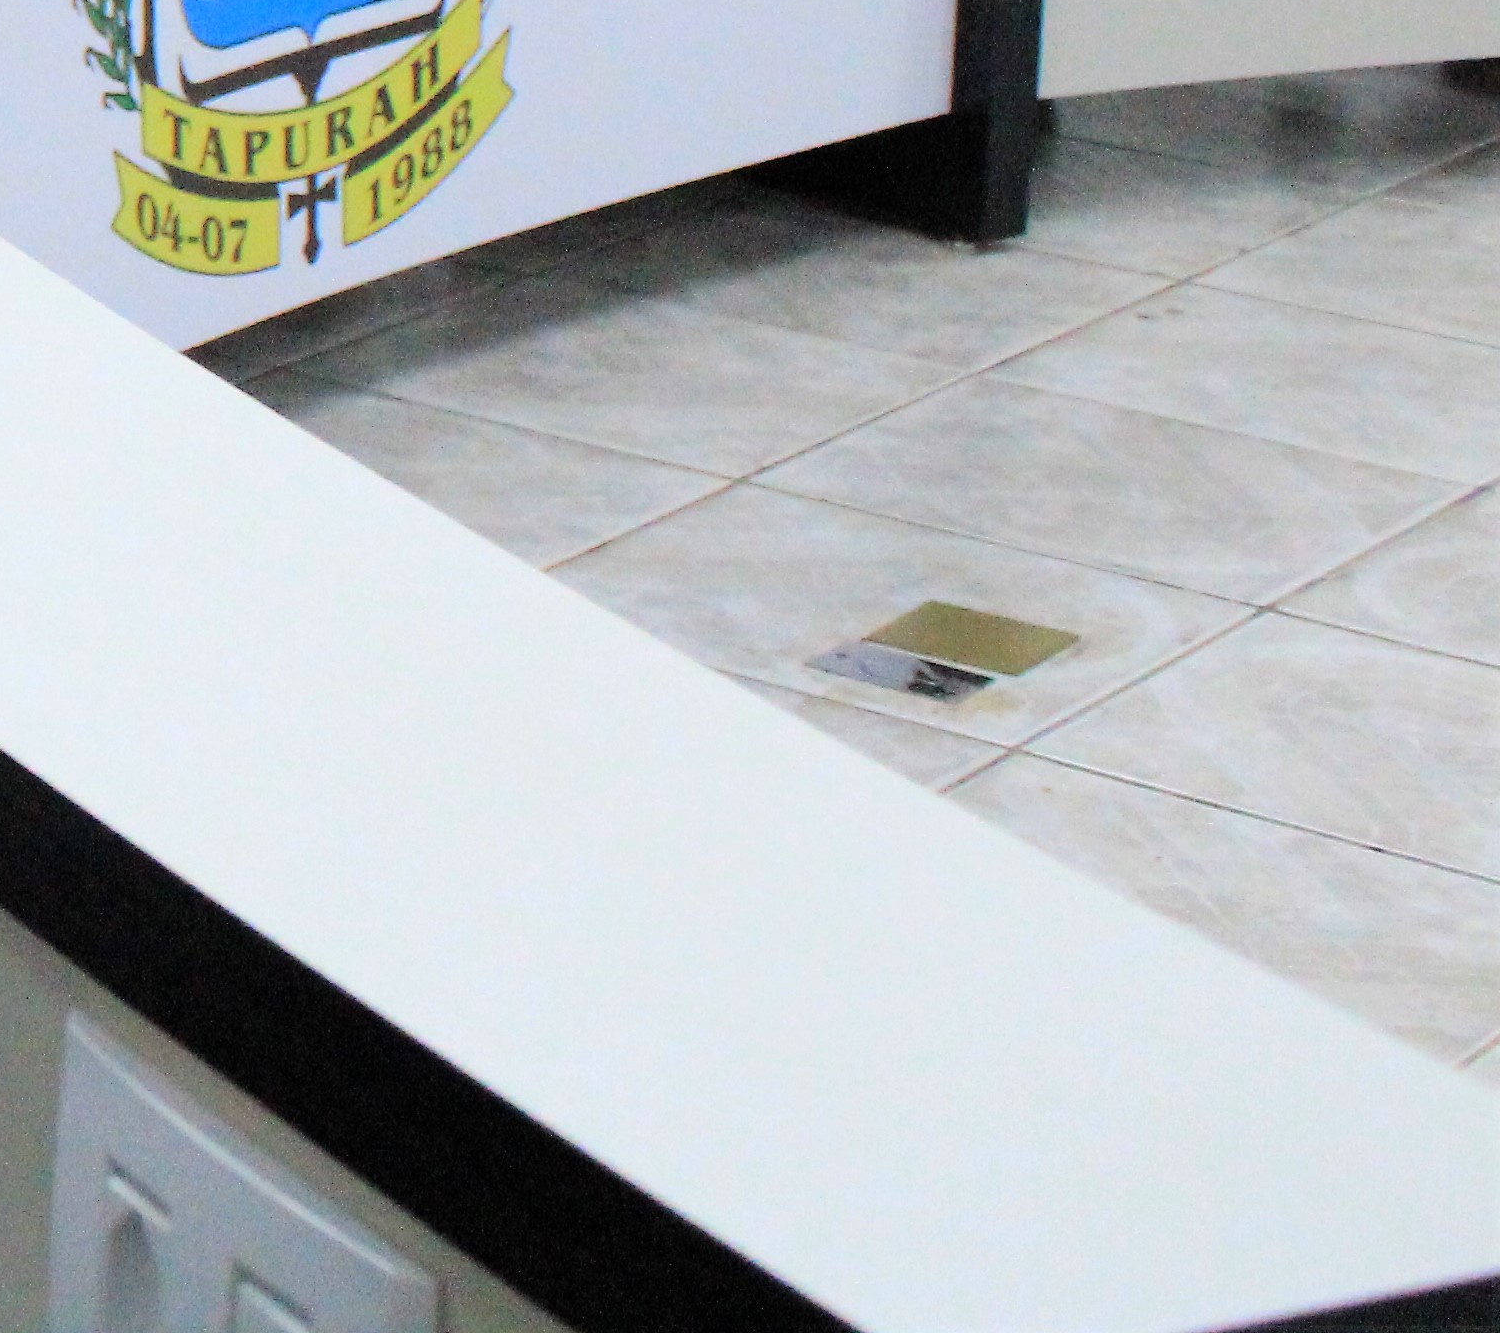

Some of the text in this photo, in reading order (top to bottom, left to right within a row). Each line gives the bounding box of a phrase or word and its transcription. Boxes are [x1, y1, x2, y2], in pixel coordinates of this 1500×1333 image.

[164, 42, 442, 178] TAPURAH
[364, 97, 475, 226] 1988
[135, 191, 250, 265] 04-07
